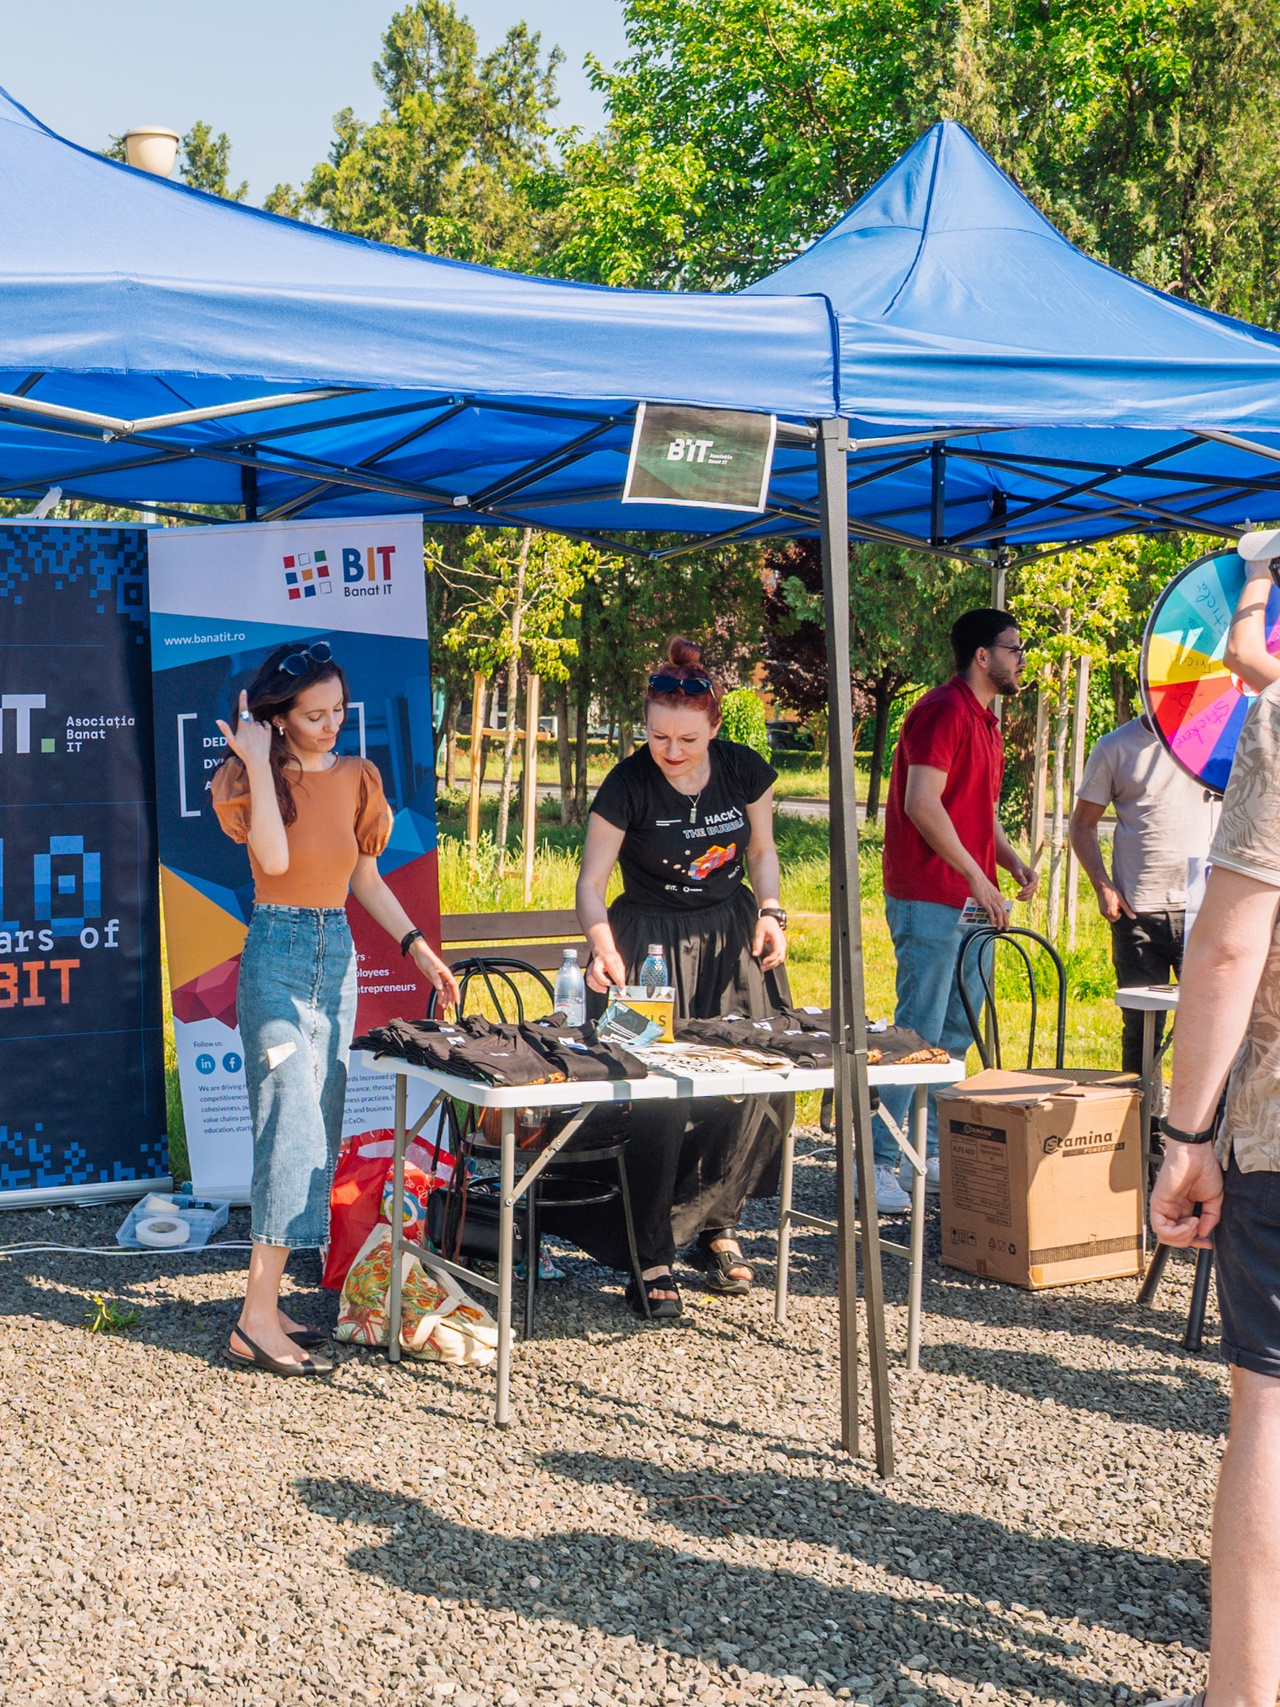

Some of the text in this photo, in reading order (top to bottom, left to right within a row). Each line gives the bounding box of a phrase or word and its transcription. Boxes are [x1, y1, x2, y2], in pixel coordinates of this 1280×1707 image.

[666, 438, 714, 463] BIT
[341, 545, 396, 583] BIT
[343, 583, 393, 598] Banat IT
[163, 631, 246, 647] www.banatit.ro
[65, 715, 136, 729] Asociația
[66, 728, 107, 740] Banat
[66, 741, 83, 753] IT
[704, 809, 736, 826] HACK
[682, 827, 707, 840] THE
[79, 918, 120, 950] of
[193, 1041, 214, 1049] Follow
[359, 1073, 390, 1082] increased
[220, 1083, 243, 1092] driving
[353, 1105, 366, 1114] and
[365, 1105, 393, 1113] business
[202, 1116, 220, 1124] value
[219, 1114, 239, 1123] chains
[203, 1126, 236, 1135] education,
[1043, 1130, 1113, 1155] Stamina
